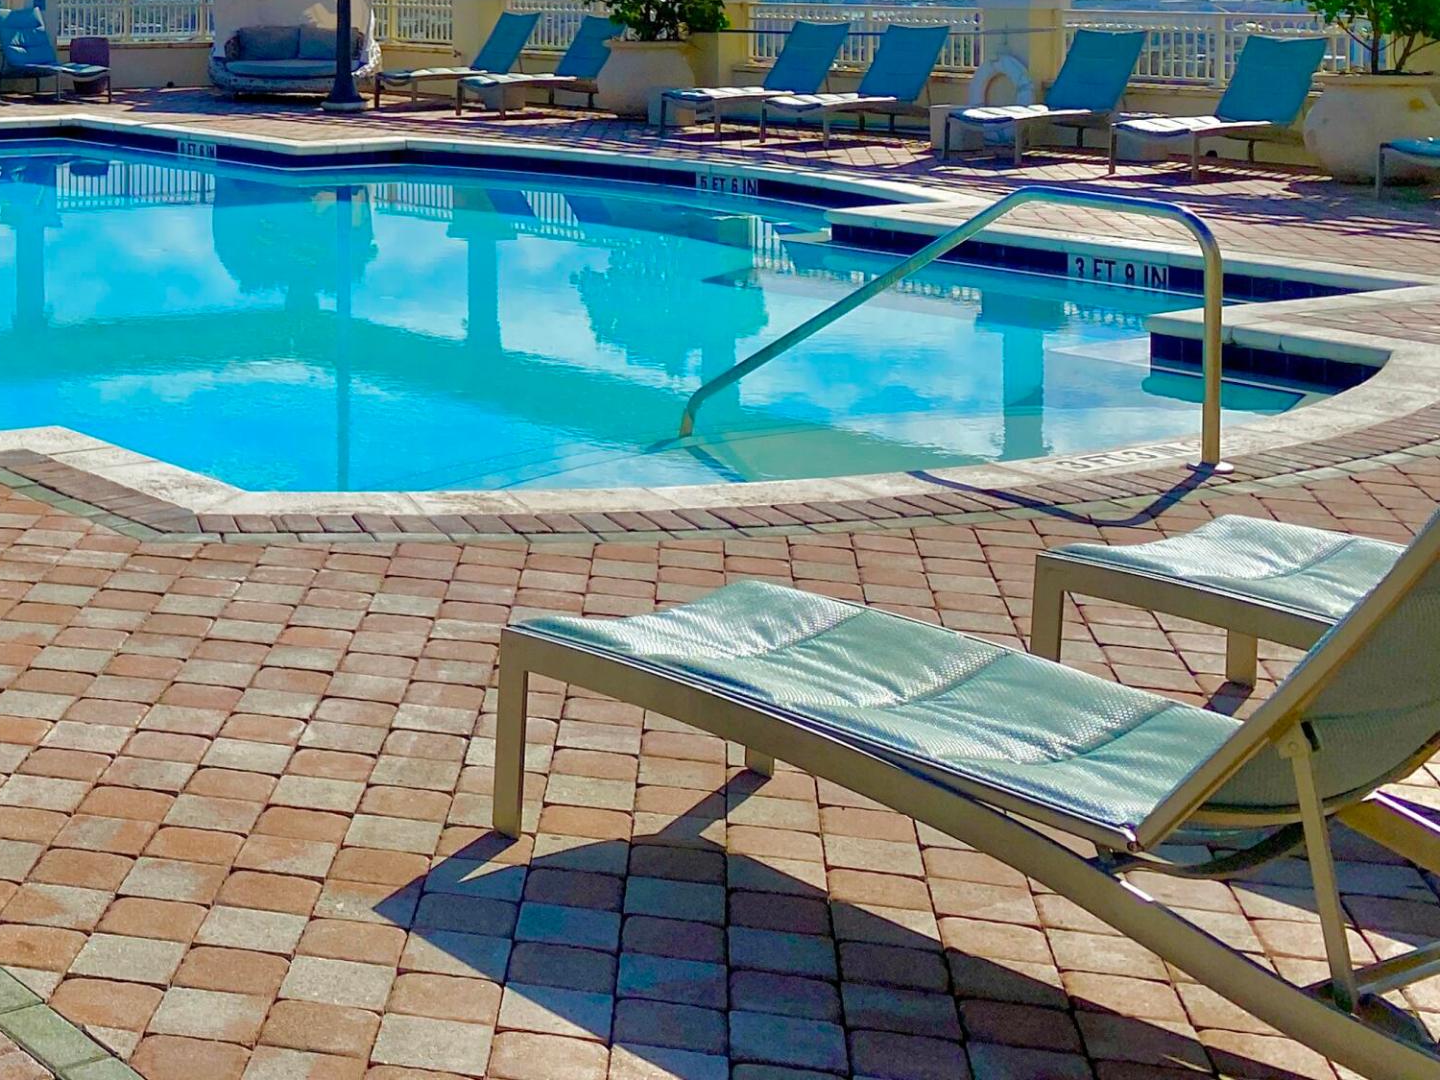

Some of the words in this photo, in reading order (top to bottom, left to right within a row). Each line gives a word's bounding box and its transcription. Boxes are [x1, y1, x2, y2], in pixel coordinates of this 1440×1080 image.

[712, 176, 726, 192] FT
[743, 179, 759, 195] IN
[1075, 257, 1085, 278] 3
[1093, 258, 1117, 280] FT
[1143, 265, 1167, 287] IN
